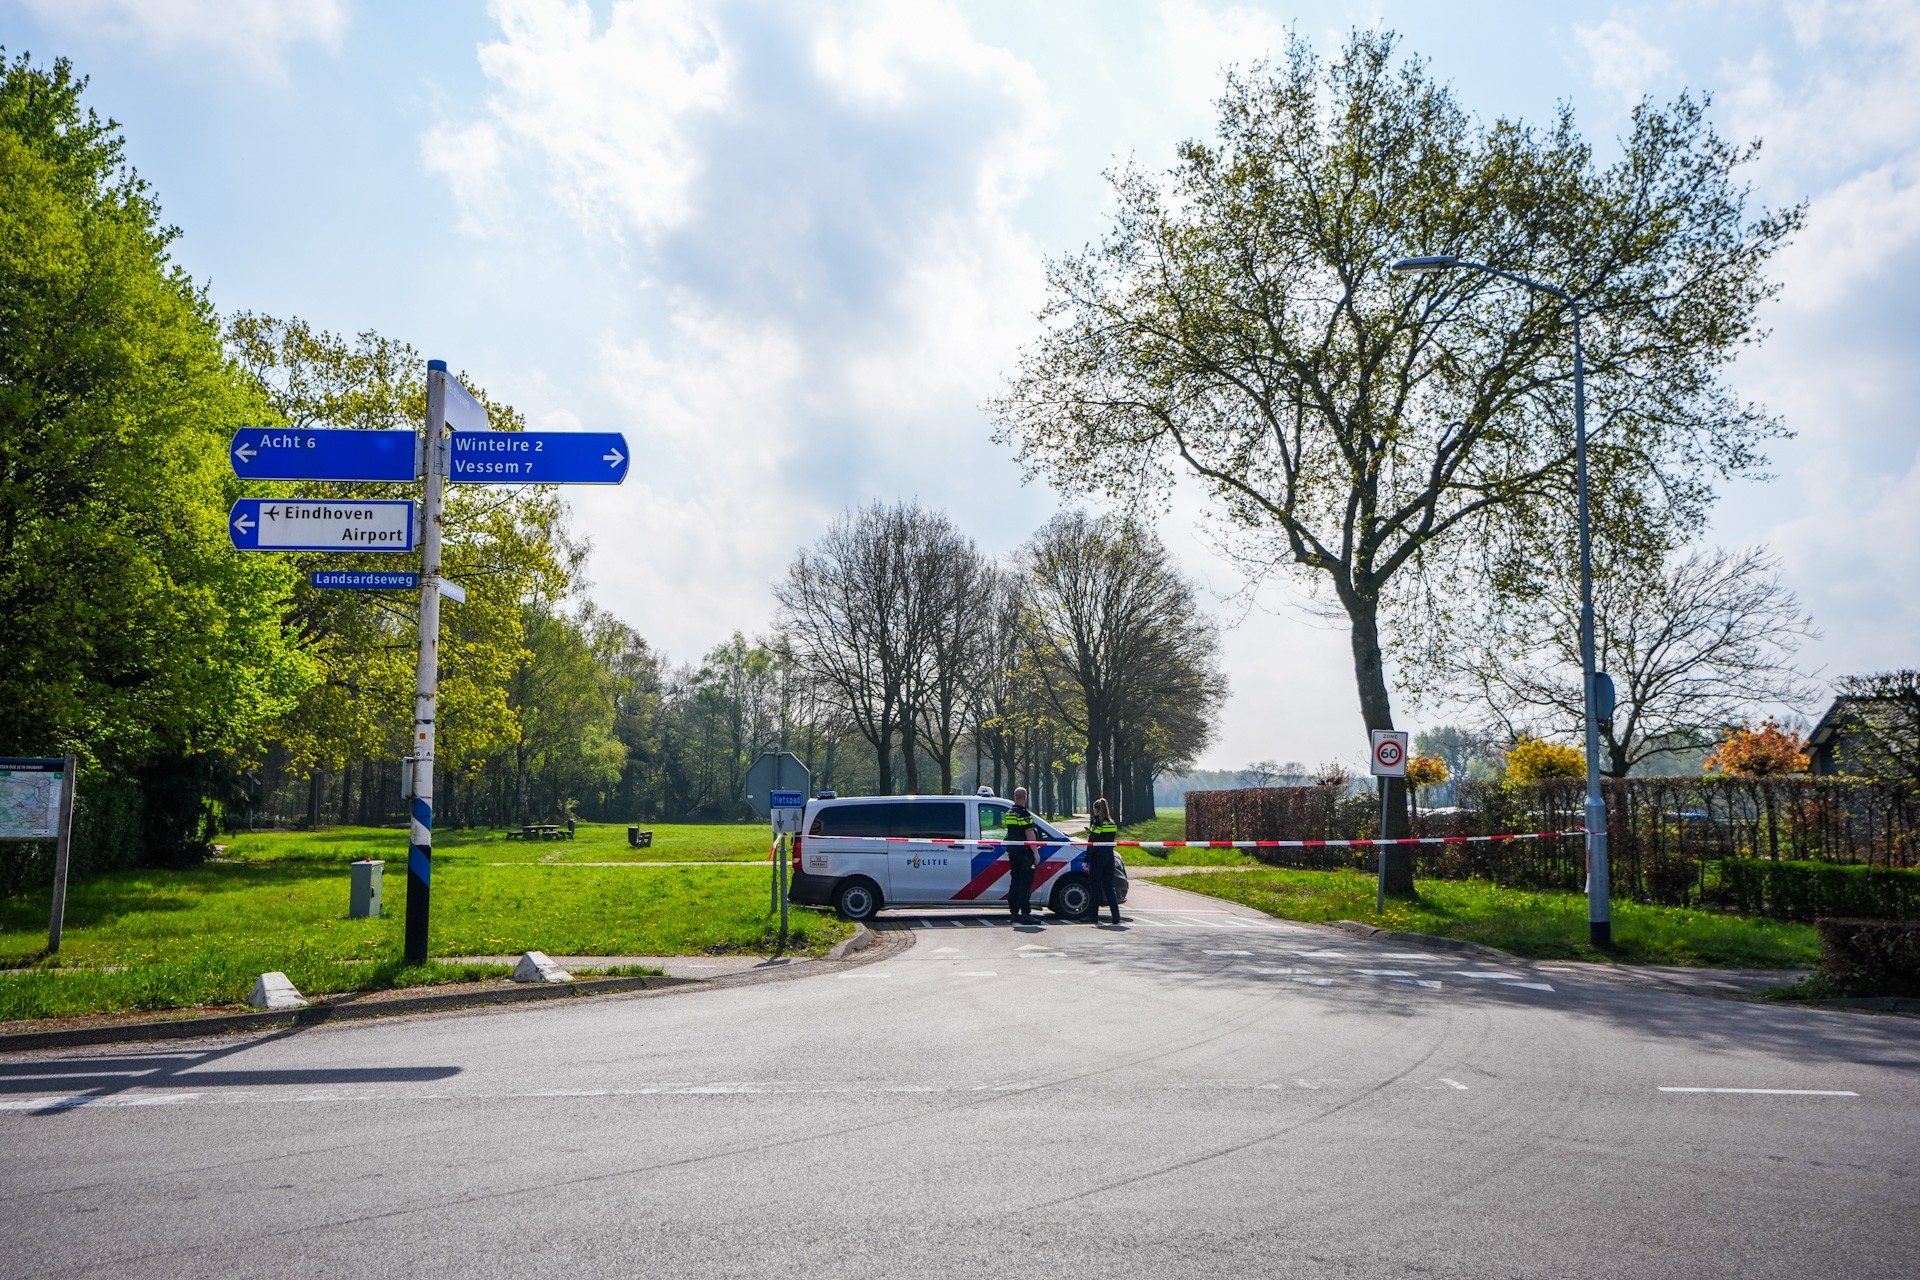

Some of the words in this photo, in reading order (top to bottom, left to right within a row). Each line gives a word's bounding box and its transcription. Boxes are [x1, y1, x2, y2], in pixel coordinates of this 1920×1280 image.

[260, 434, 301, 449] Acht
[307, 437, 316, 449] 6
[455, 437, 530, 452] Wintelre
[535, 440, 544, 452] 2
[454, 459, 519, 474] Vessem
[525, 462, 533, 474] 7
[285, 506, 373, 520] Eindhoven
[342, 528, 403, 544] Airport
[316, 573, 413, 587] Landsardseweg
[1381, 748, 1398, 758] 60
